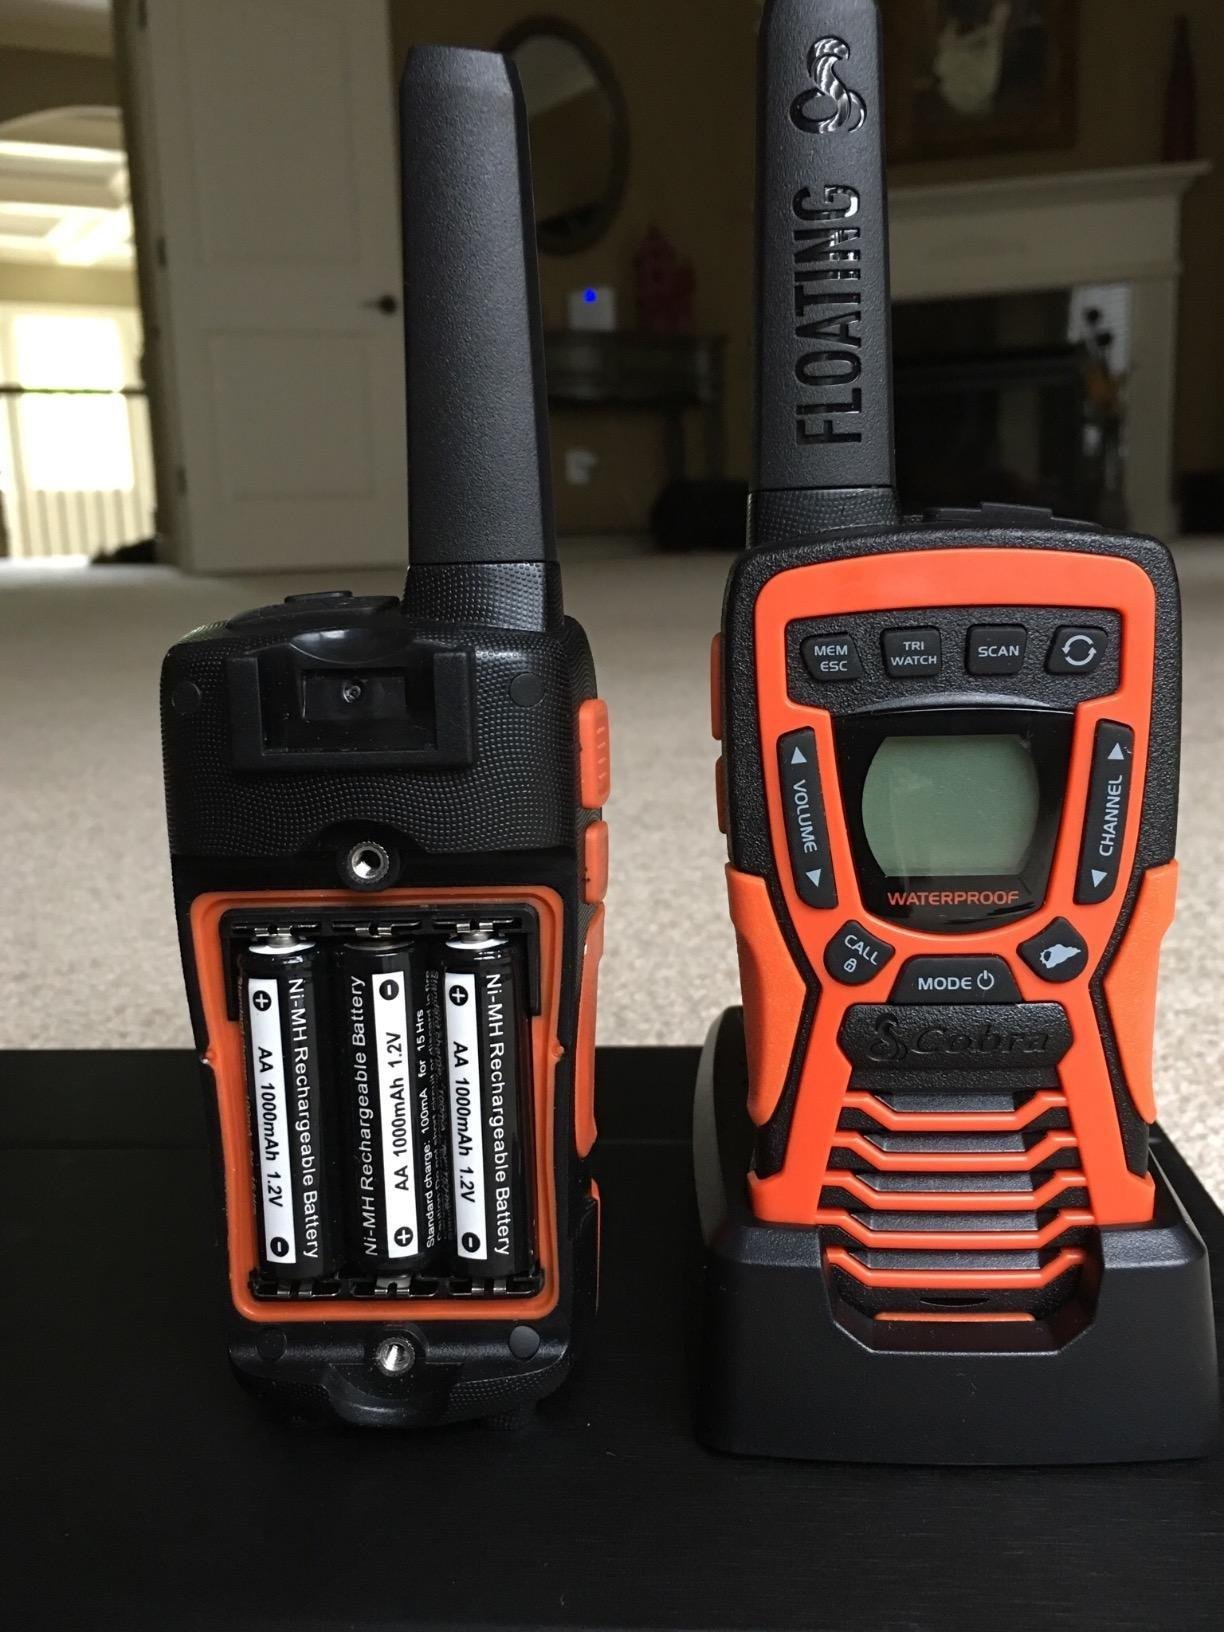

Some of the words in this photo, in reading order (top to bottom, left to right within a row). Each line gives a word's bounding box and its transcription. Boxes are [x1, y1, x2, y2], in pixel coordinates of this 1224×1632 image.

[793, 184, 862, 445] FLOATING
[814, 644, 848, 656] MEM
[820, 660, 848, 672] ESC
[891, 655, 937, 666] WATCH
[903, 641, 925, 651] TRI
[978, 645, 1019, 658] SCAN
[793, 780, 818, 853] VOLUME
[1099, 775, 1123, 856] CHANNEL
[887, 891, 1019, 906] WATERPROOF
[844, 934, 878, 966] CALL
[486, 974, 504, 1037] Ni-MH
[918, 976, 972, 990] MODE
[288, 978, 308, 1041] Ni-MH
[350, 976, 367, 1046] Battery
[258, 1047, 273, 1073] AA
[386, 1032, 403, 1068] 1.2V
[453, 1041, 469, 1068] AA
[908, 1022, 1050, 1054] Cobra
[418, 1060, 427, 1078] for
[261, 1083, 280, 1161] 1000mAh
[294, 1046, 316, 1186] Rechargeable
[354, 1052, 374, 1191] Rechargeable
[390, 1077, 408, 1157] 1000mAh
[419, 1088, 430, 1133] 100mA
[455, 1077, 473, 1156] 1000mAh
[488, 1042, 509, 1182] Rechargeable
[394, 1165, 409, 1191] AA
[423, 1140, 433, 1188] charge:
[458, 1165, 475, 1203] 1.2V
[266, 1171, 283, 1207] 1.2V
[303, 1190, 319, 1258] Battery
[361, 1197, 378, 1256] Ni-MH
[425, 1190, 435, 1248] Standard
[494, 1186, 511, 1255] Battery
